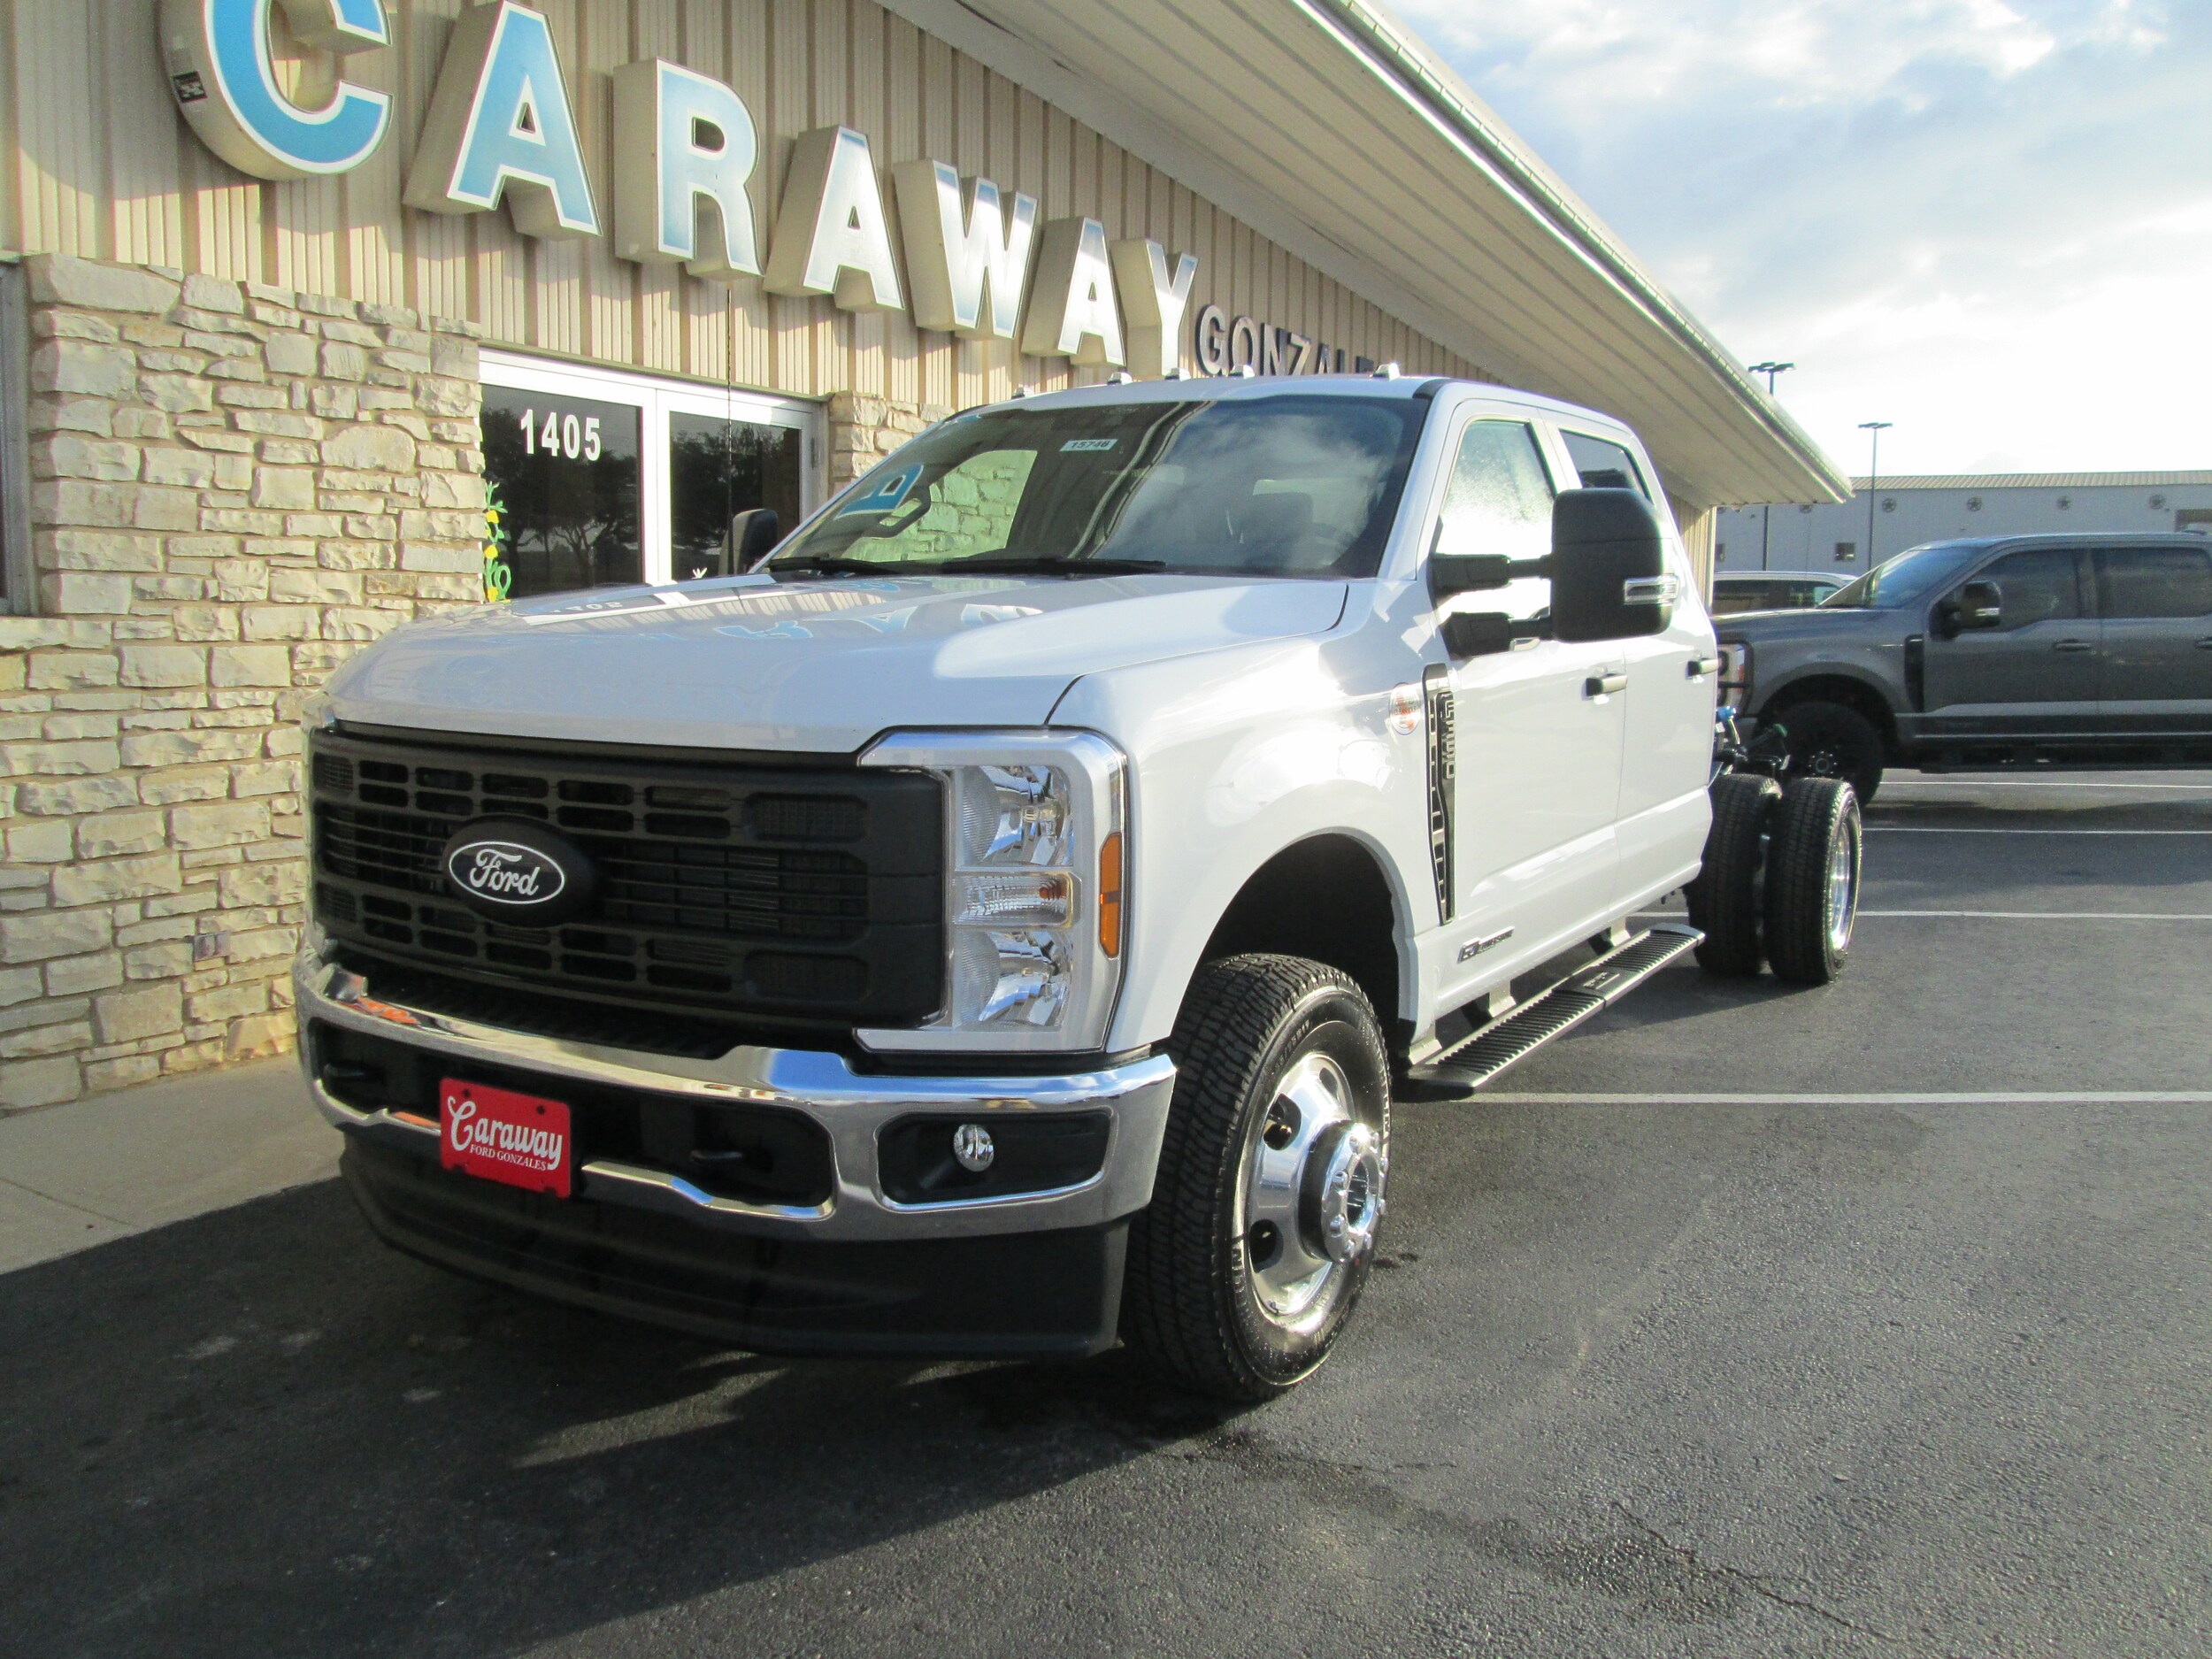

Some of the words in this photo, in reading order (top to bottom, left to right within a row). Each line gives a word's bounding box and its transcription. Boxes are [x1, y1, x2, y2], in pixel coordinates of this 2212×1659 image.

[200, 0, 1198, 377] CARAWAY
[519, 409, 602, 462] 1405
[469, 849, 541, 896] Ford
[447, 1095, 563, 1171] Caraway
[470, 1143, 495, 1158] FORD
[496, 1150, 547, 1171] GONZALES
